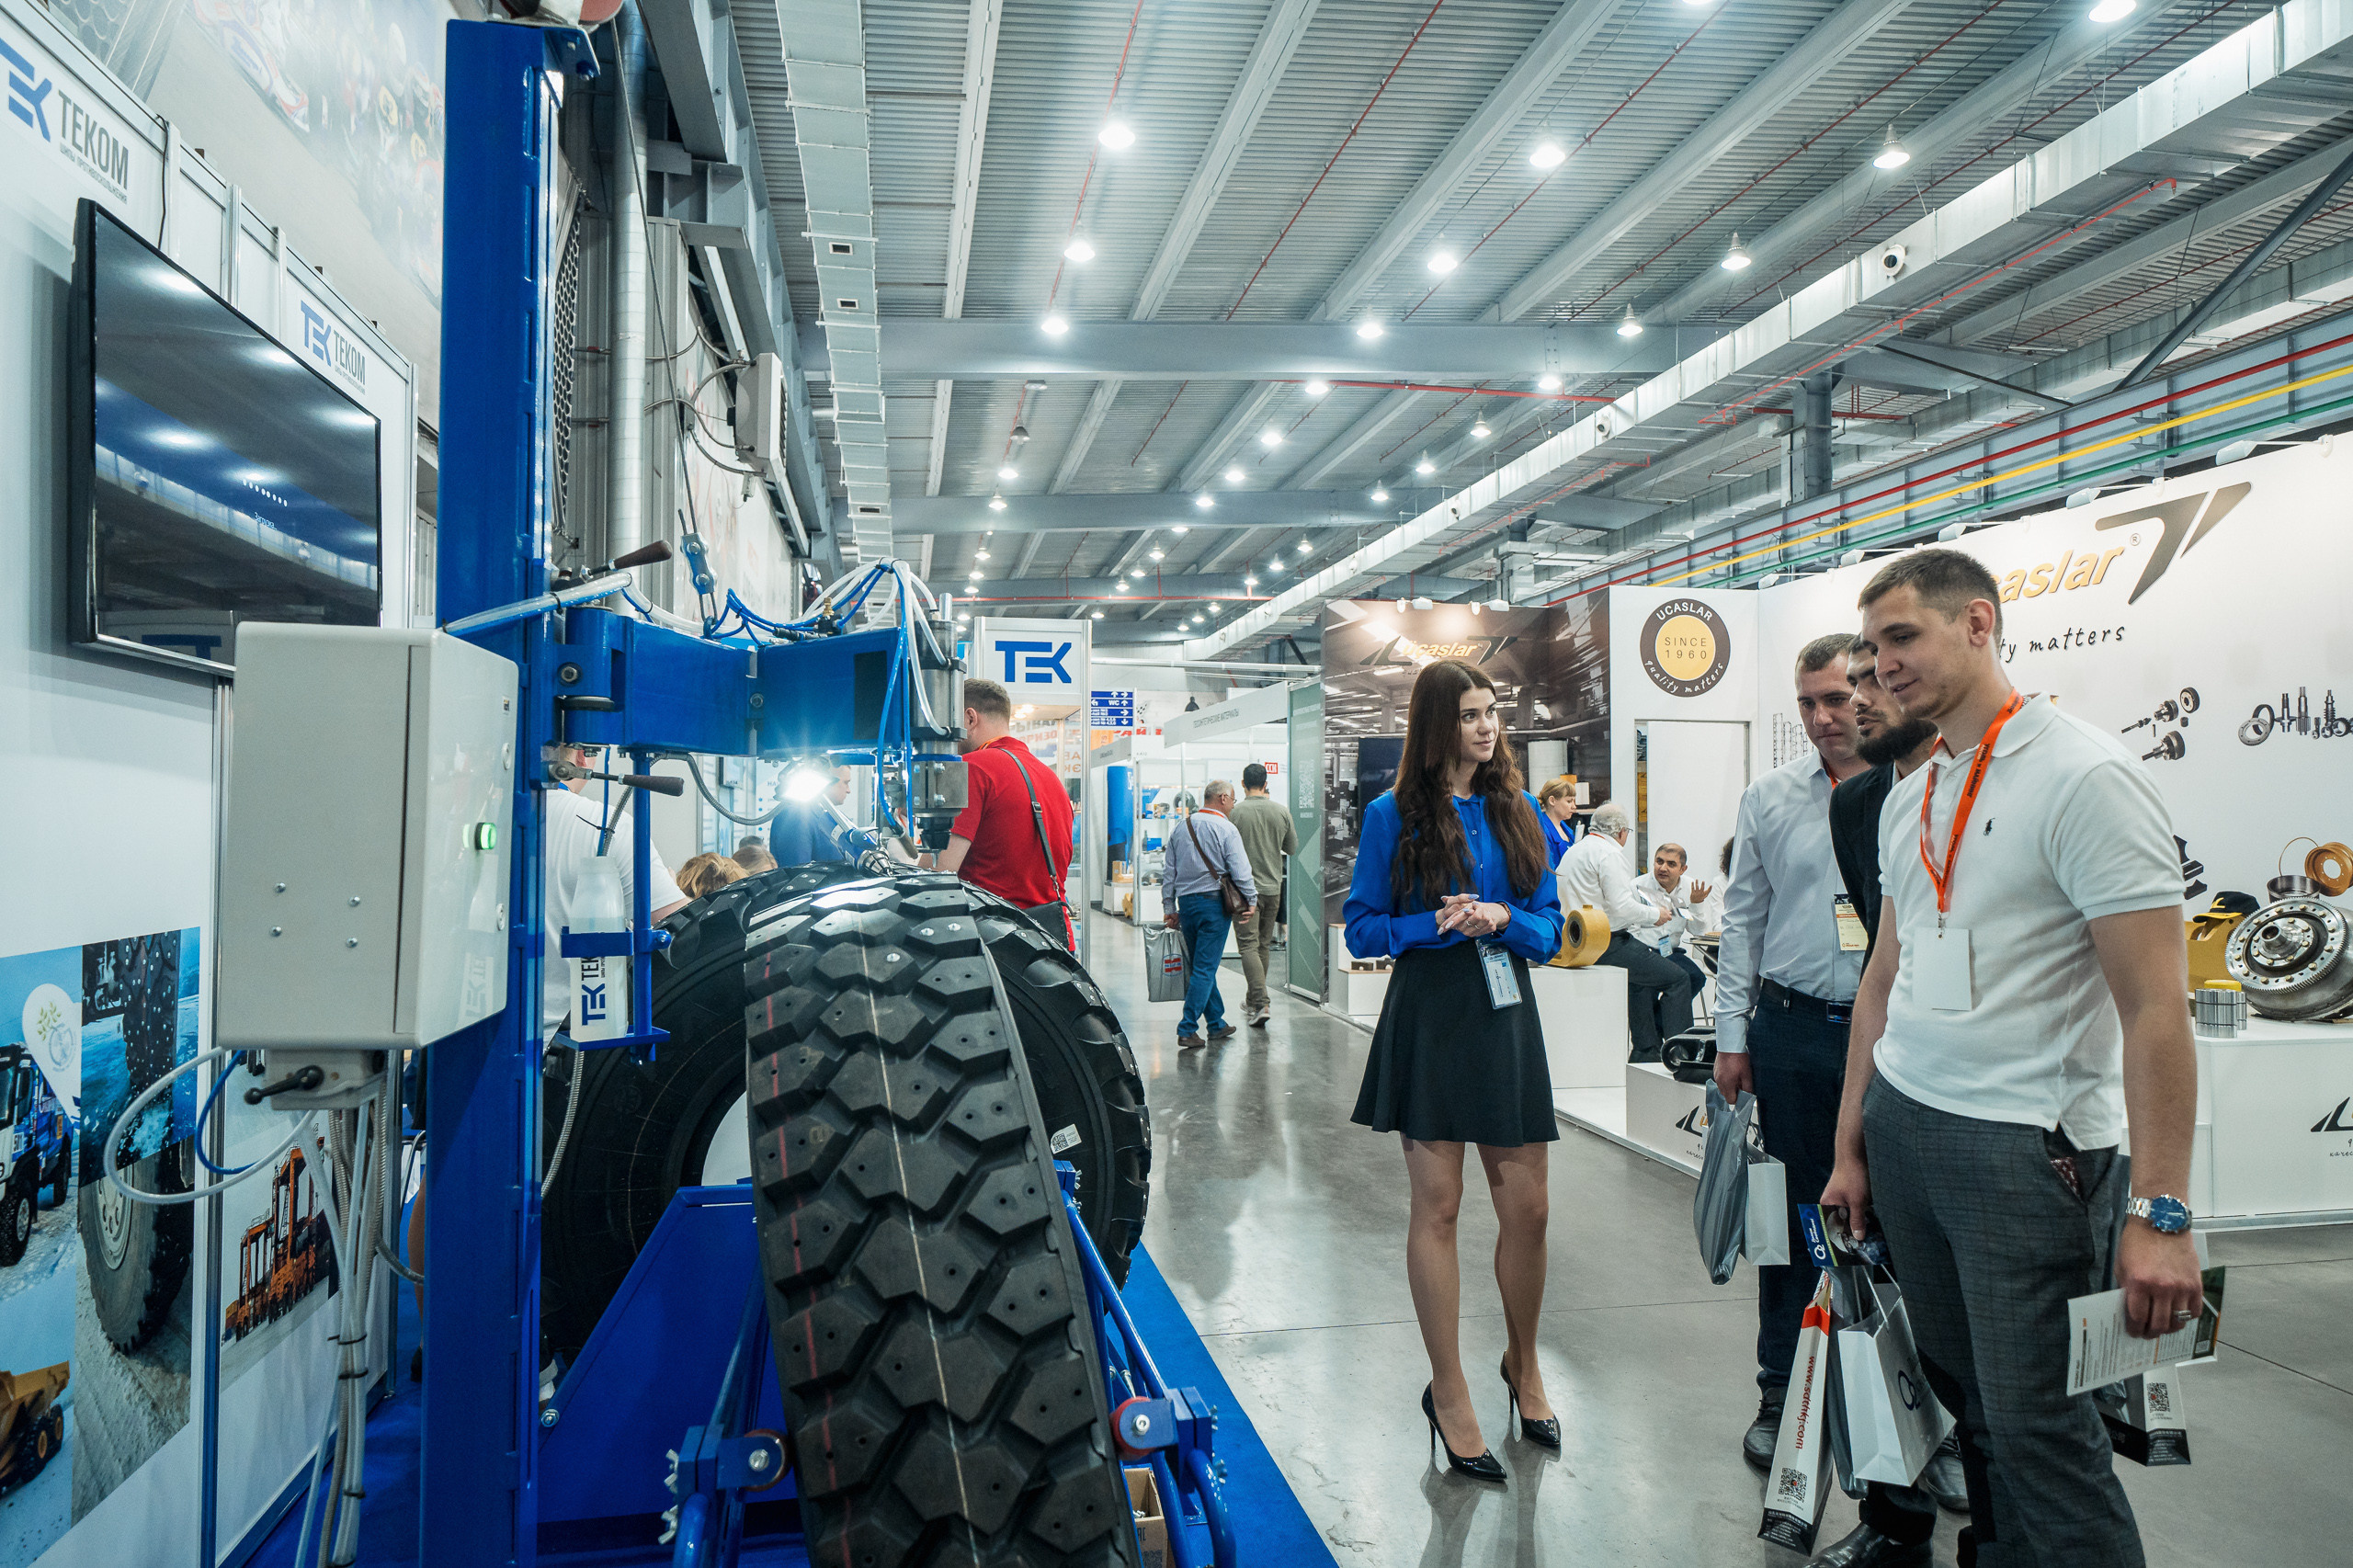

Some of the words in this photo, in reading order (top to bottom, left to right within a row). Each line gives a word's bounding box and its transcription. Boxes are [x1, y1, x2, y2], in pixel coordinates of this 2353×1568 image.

[0, 38, 51, 143] EK
[59, 89, 129, 189] TEKOM
[301, 300, 331, 368] TEK
[334, 329, 366, 386] TEKOM
[1991, 546, 2125, 604] aslar
[1656, 602, 1712, 621] UCASLAR
[1665, 636, 1707, 647] SINCE
[1665, 649, 1708, 660] 1960
[2029, 626, 2125, 653] matters
[995, 641, 1072, 684] TEK
[1644, 660, 1678, 693] quality
[1685, 663, 1723, 693] matters
[581, 957, 599, 982] TEK
[581, 983, 606, 1026] TEK
